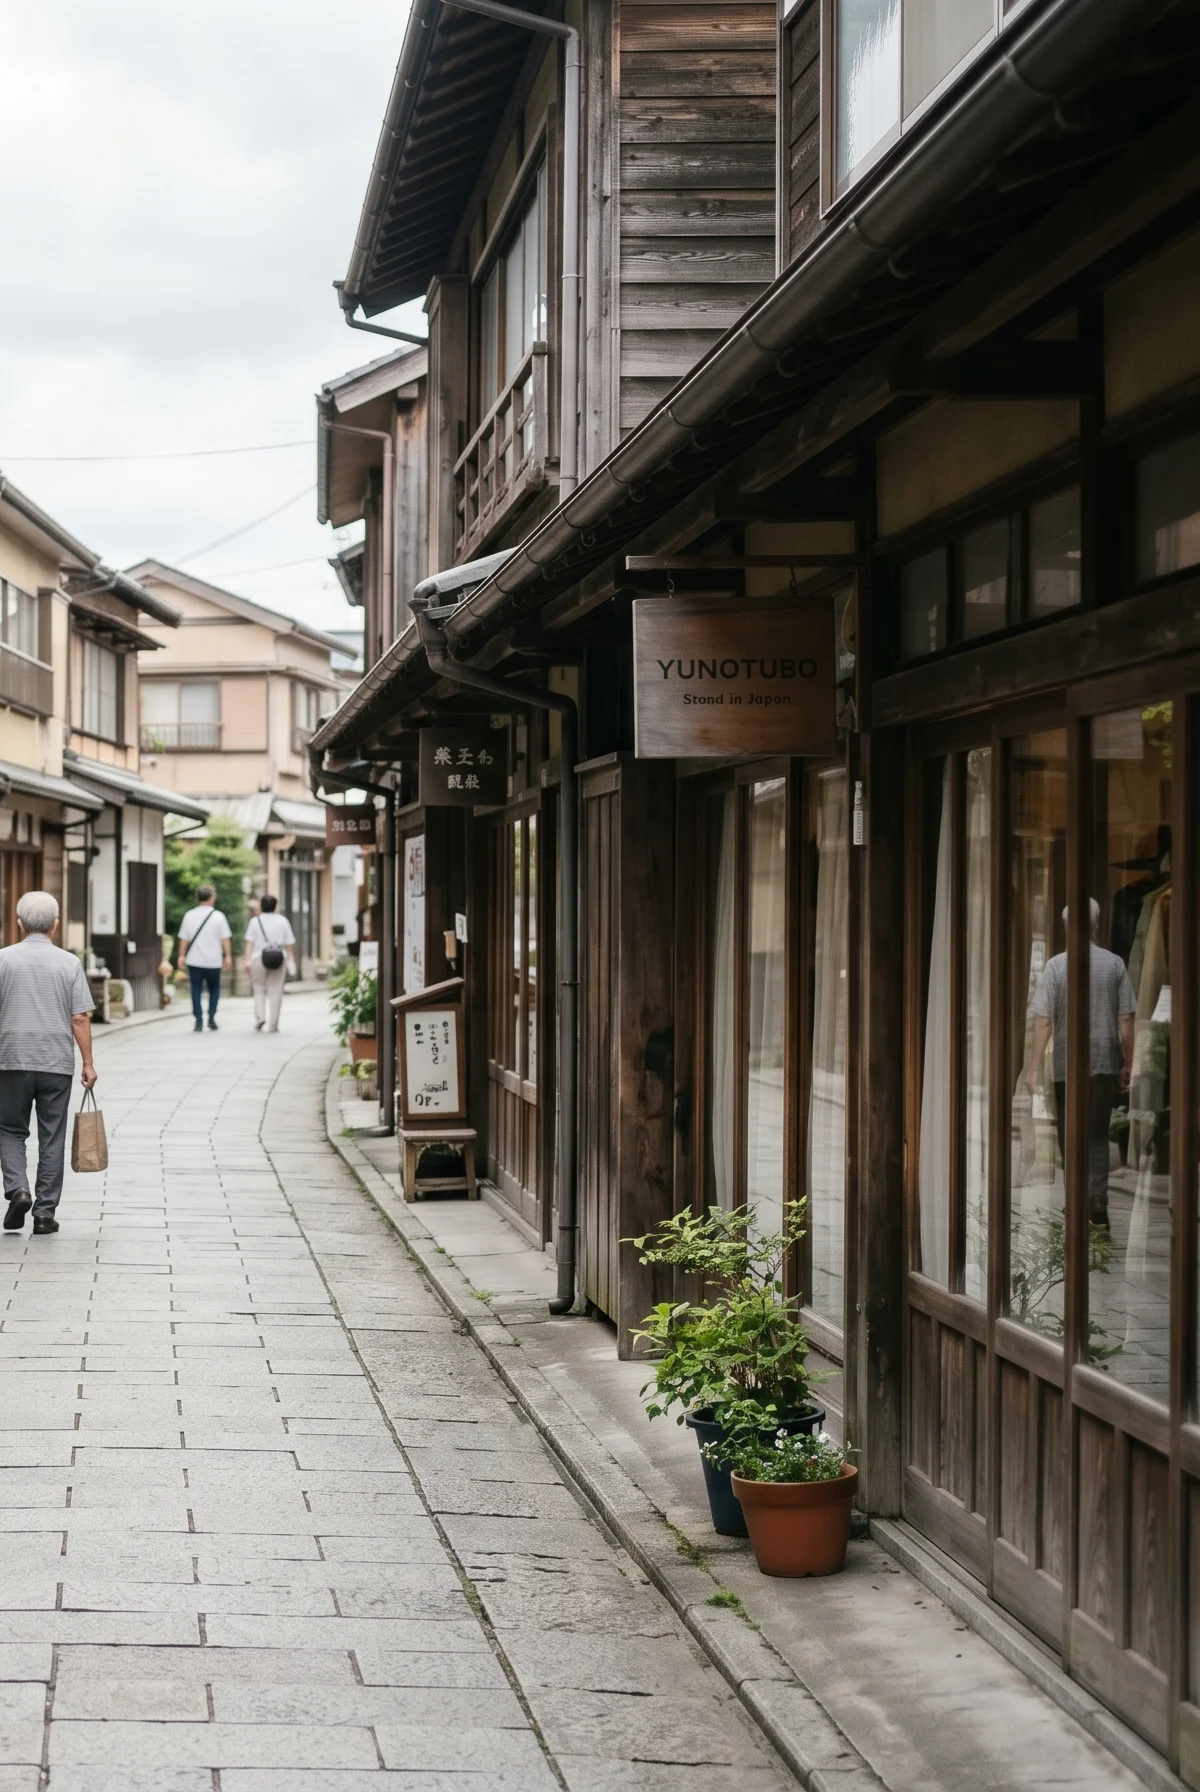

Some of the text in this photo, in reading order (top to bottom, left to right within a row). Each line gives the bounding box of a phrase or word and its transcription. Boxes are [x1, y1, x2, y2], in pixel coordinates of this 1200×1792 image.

[657, 658, 818, 680] YUNOTUBO
[729, 693, 742, 705] in
[747, 693, 791, 708] Japan
